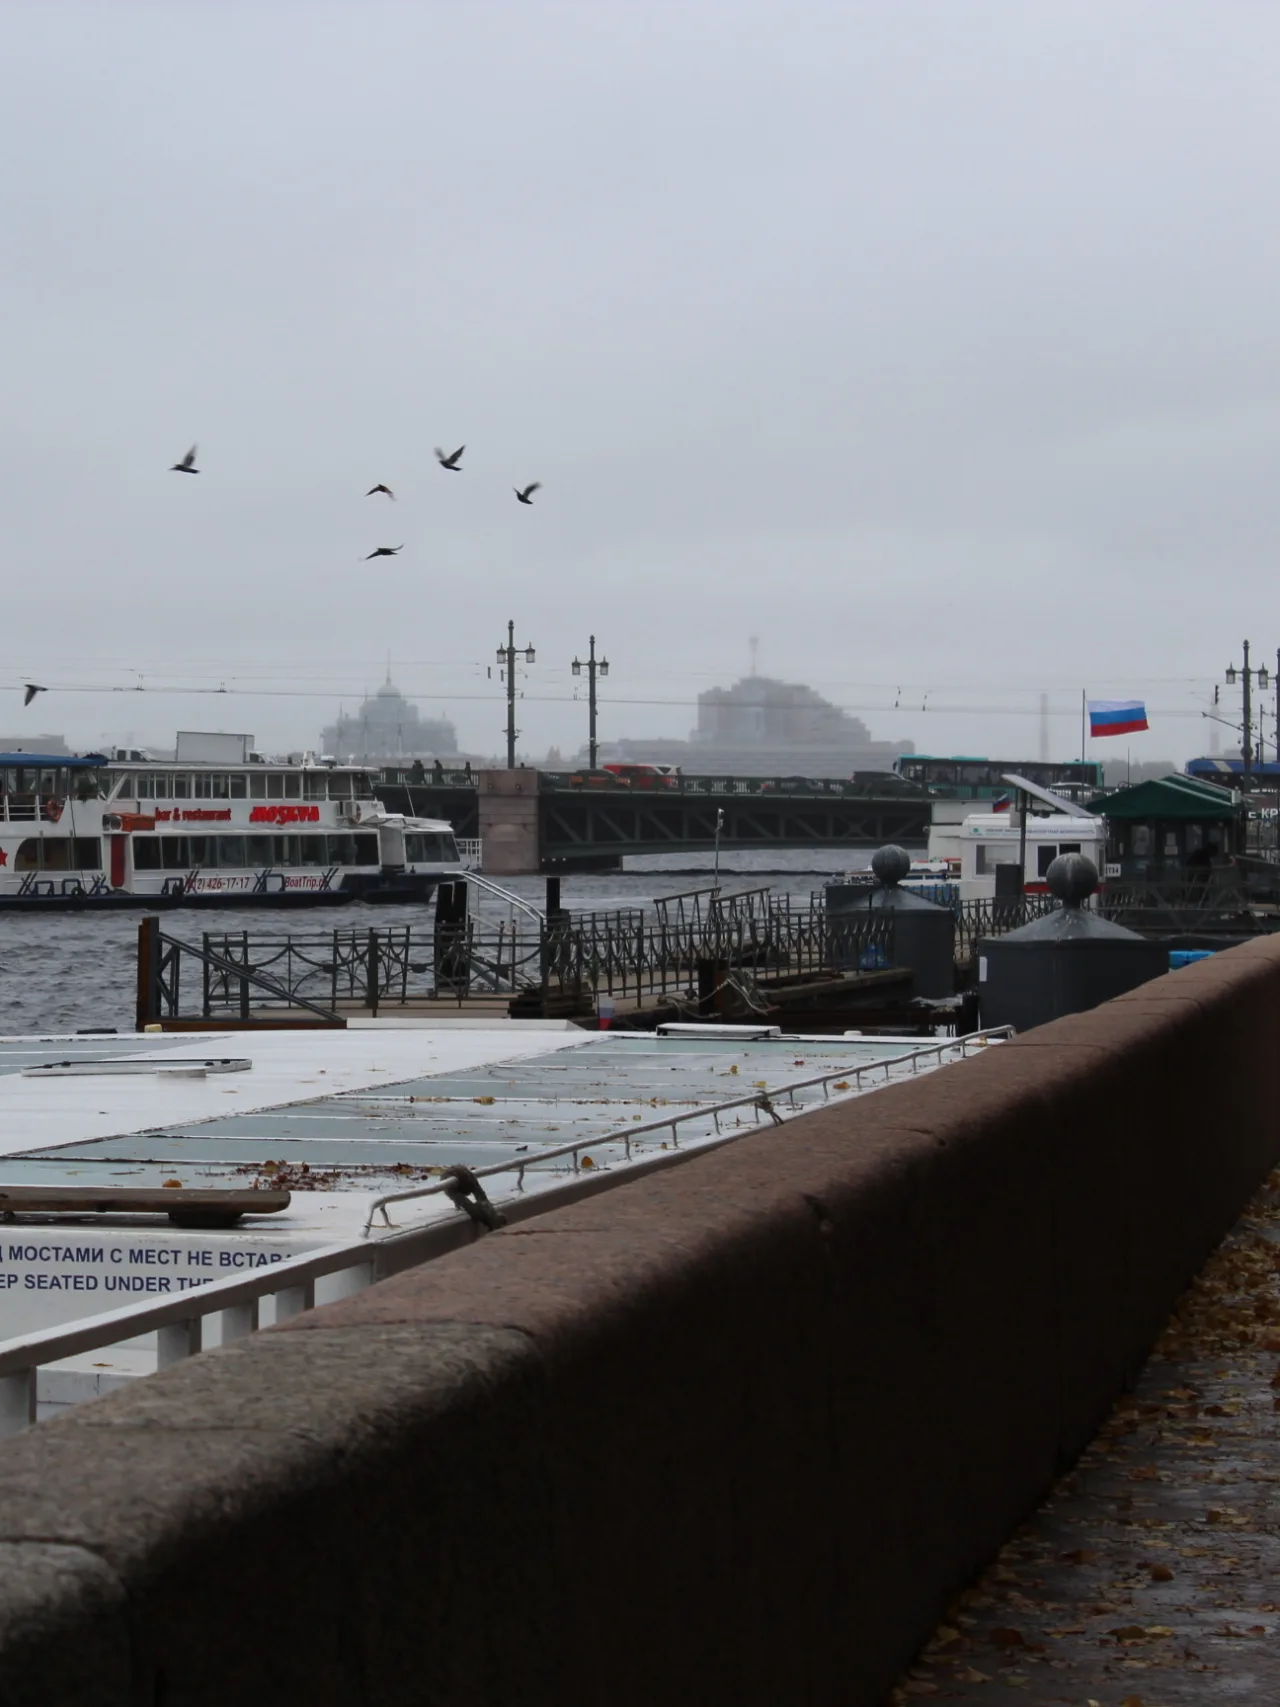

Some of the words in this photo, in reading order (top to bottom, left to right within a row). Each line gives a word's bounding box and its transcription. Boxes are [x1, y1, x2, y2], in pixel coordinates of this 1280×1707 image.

[8, 1245, 104, 1264] МОСТАМИ
[129, 1249, 183, 1266] МЕСТ
[188, 1250, 213, 1266] НЕ
[219, 1251, 292, 1268] ВСТАВ
[24, 1274, 98, 1291] SEATED
[104, 1275, 171, 1292] UNDER
